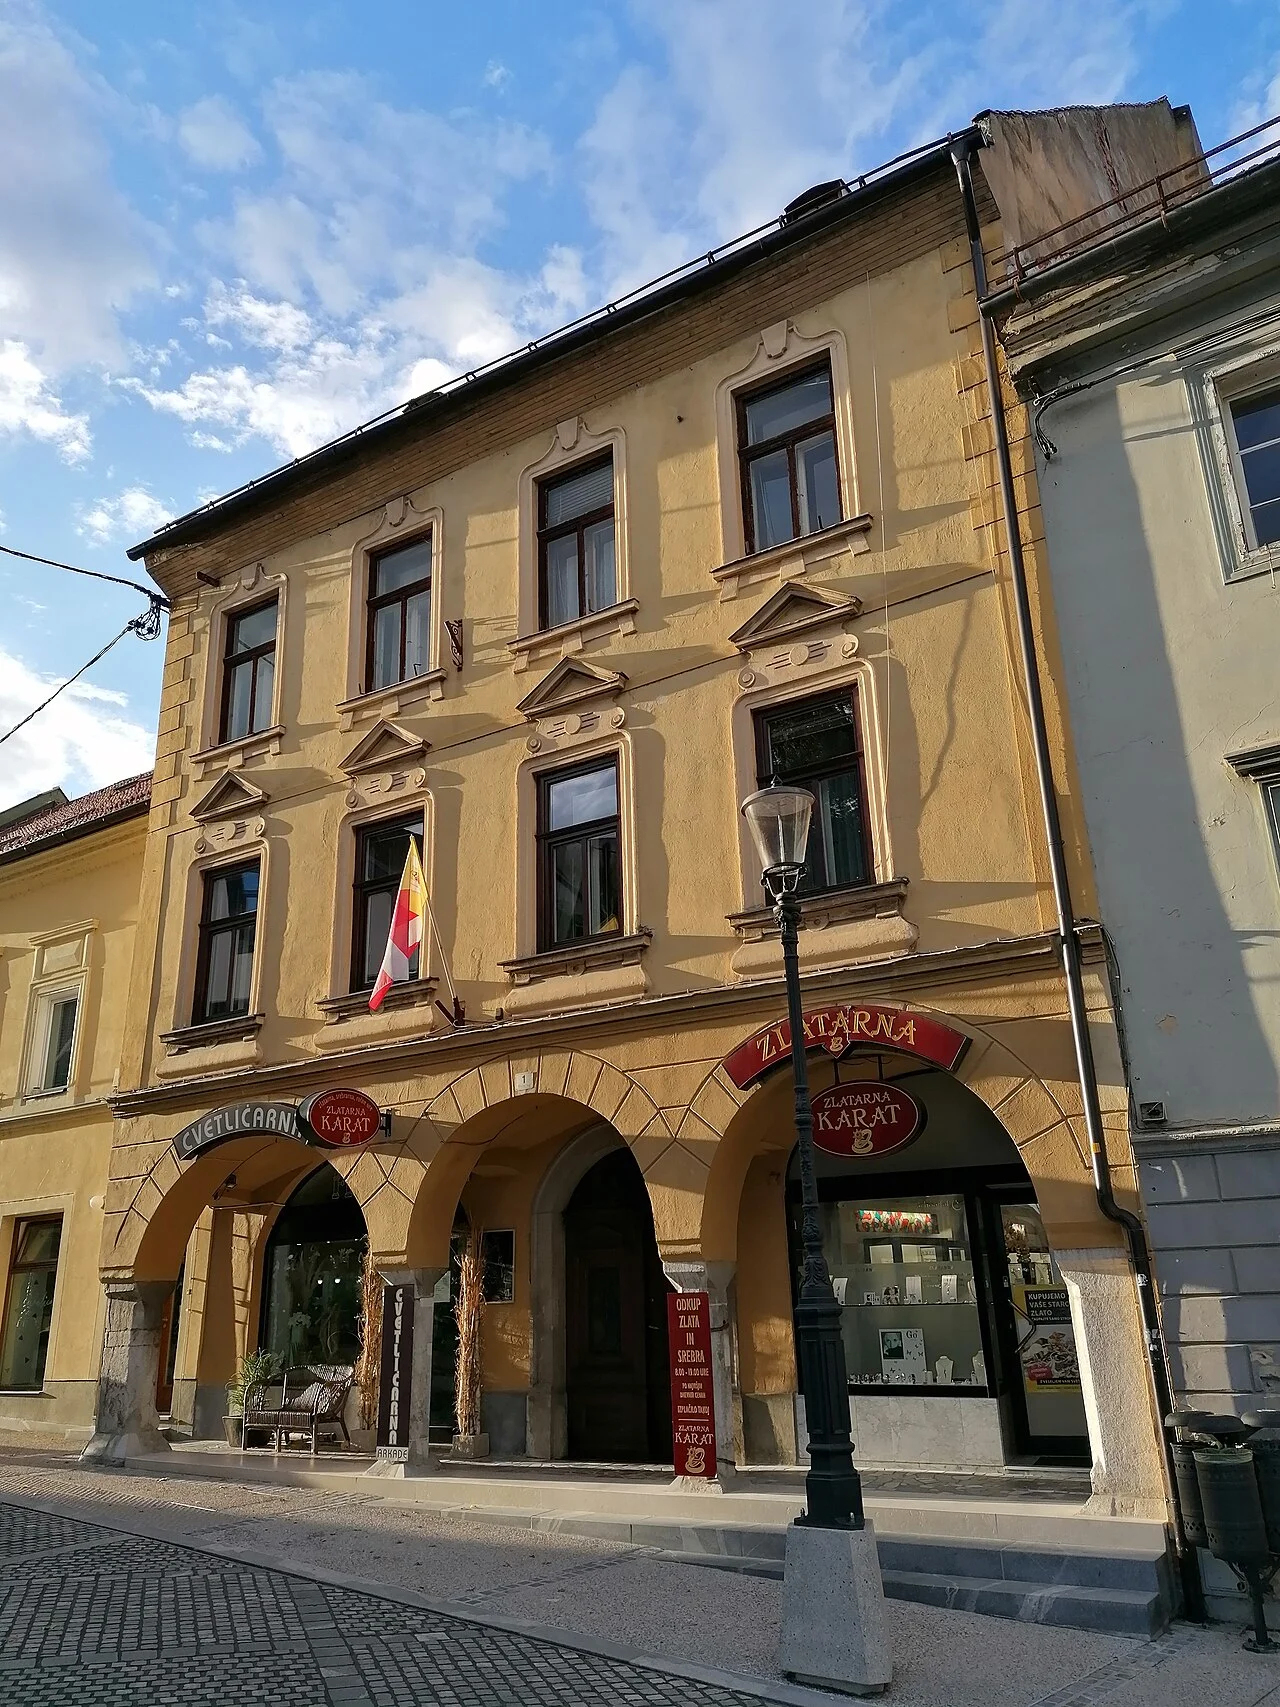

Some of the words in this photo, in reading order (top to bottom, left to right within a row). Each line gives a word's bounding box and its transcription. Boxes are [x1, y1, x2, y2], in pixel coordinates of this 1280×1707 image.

[757, 1010, 916, 1061] ZLATARNA
[521, 1074, 526, 1084] 1
[823, 1091, 891, 1109] ZLATARNA
[326, 1105, 366, 1116] ZLATARNA
[321, 1115, 371, 1132] KARAT
[818, 1104, 901, 1131] KARAT
[1028, 1292, 1066, 1300] KUPUJEMO
[676, 1297, 701, 1311] ODKUP
[1030, 1309, 1053, 1317] ZLATO
[678, 1315, 700, 1329] ZLATA
[686, 1332, 695, 1346] IN
[677, 1350, 705, 1363] SREBRA
[389, 1288, 404, 1445] CVETLIČARNA
[678, 1424, 710, 1433] ZLATARNA
[675, 1432, 714, 1445] KARAT
[377, 1448, 408, 1459] ARKADE
